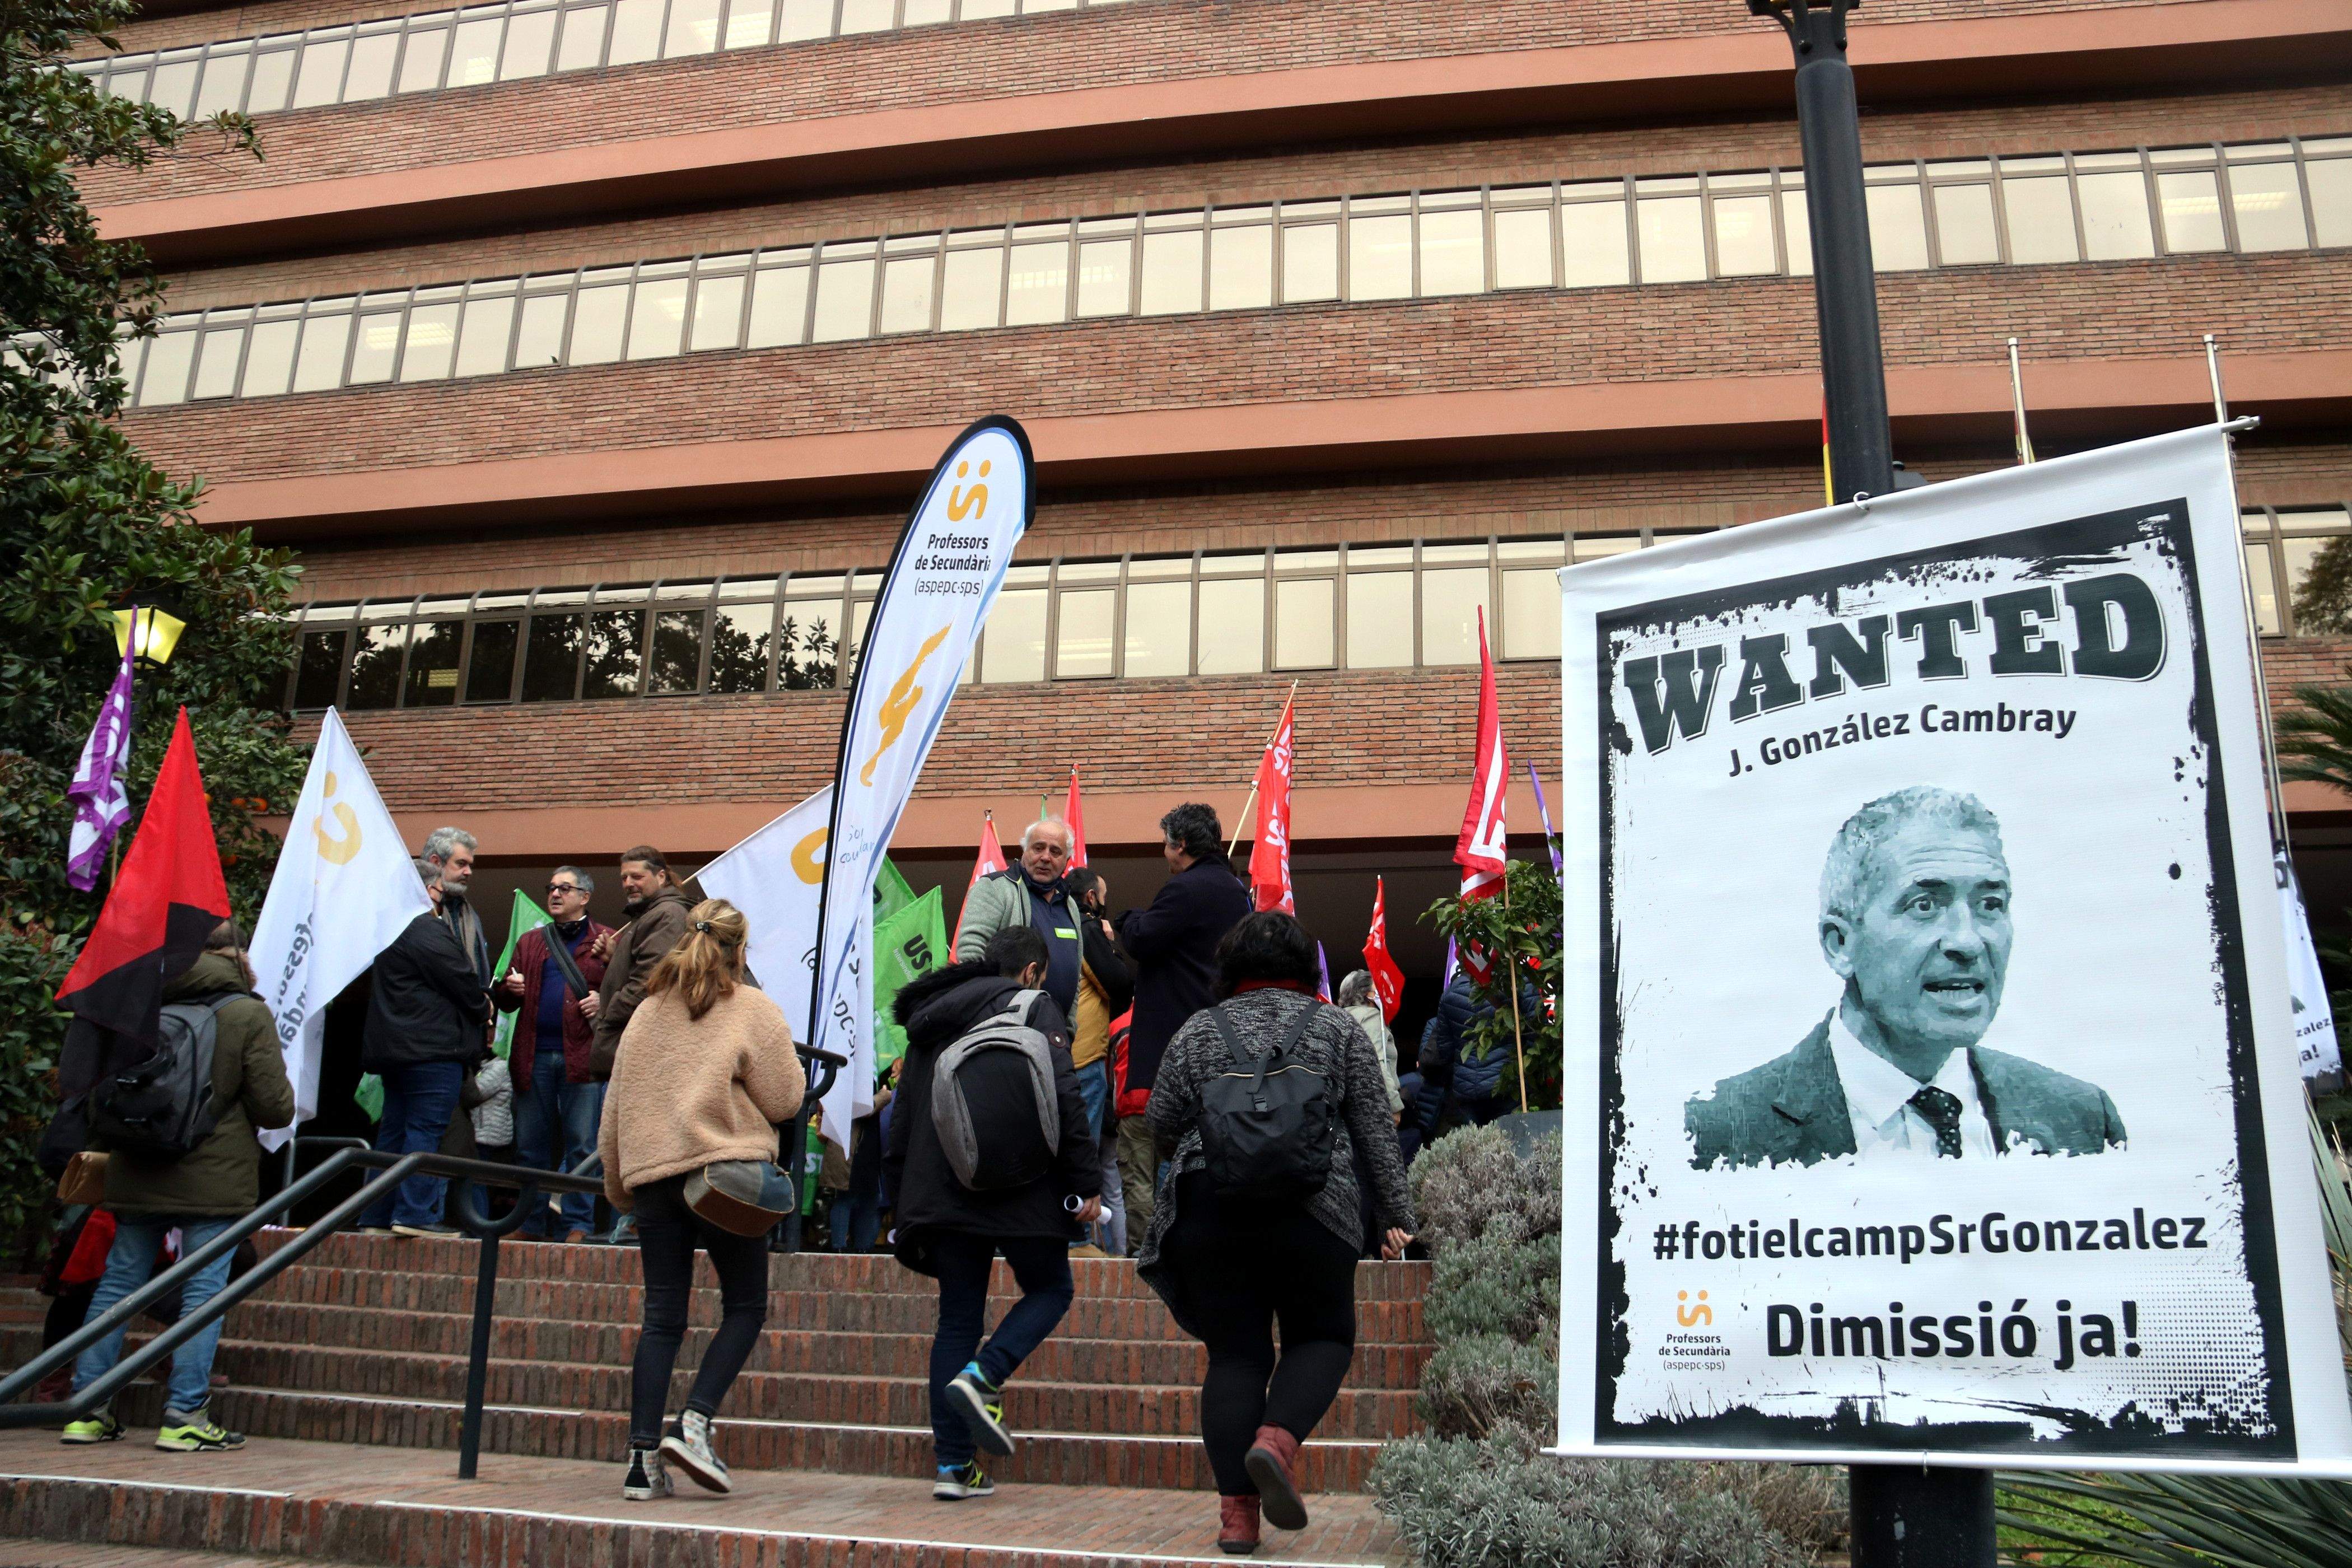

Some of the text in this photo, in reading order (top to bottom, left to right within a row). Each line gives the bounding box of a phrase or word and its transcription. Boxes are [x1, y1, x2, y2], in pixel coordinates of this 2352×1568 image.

[927, 533, 988, 549] Professors
[914, 555, 928, 570] de
[1622, 573, 2166, 755] WANTED
[1729, 702, 2076, 777] J. González Cambray
[1653, 1207, 2208, 1264] #fotielcampSrGonzalez
[1658, 1345, 1731, 1356] de Secundària
[1666, 1333, 1721, 1343] Professors
[1766, 1299, 2141, 1370] Dimissió ja!
